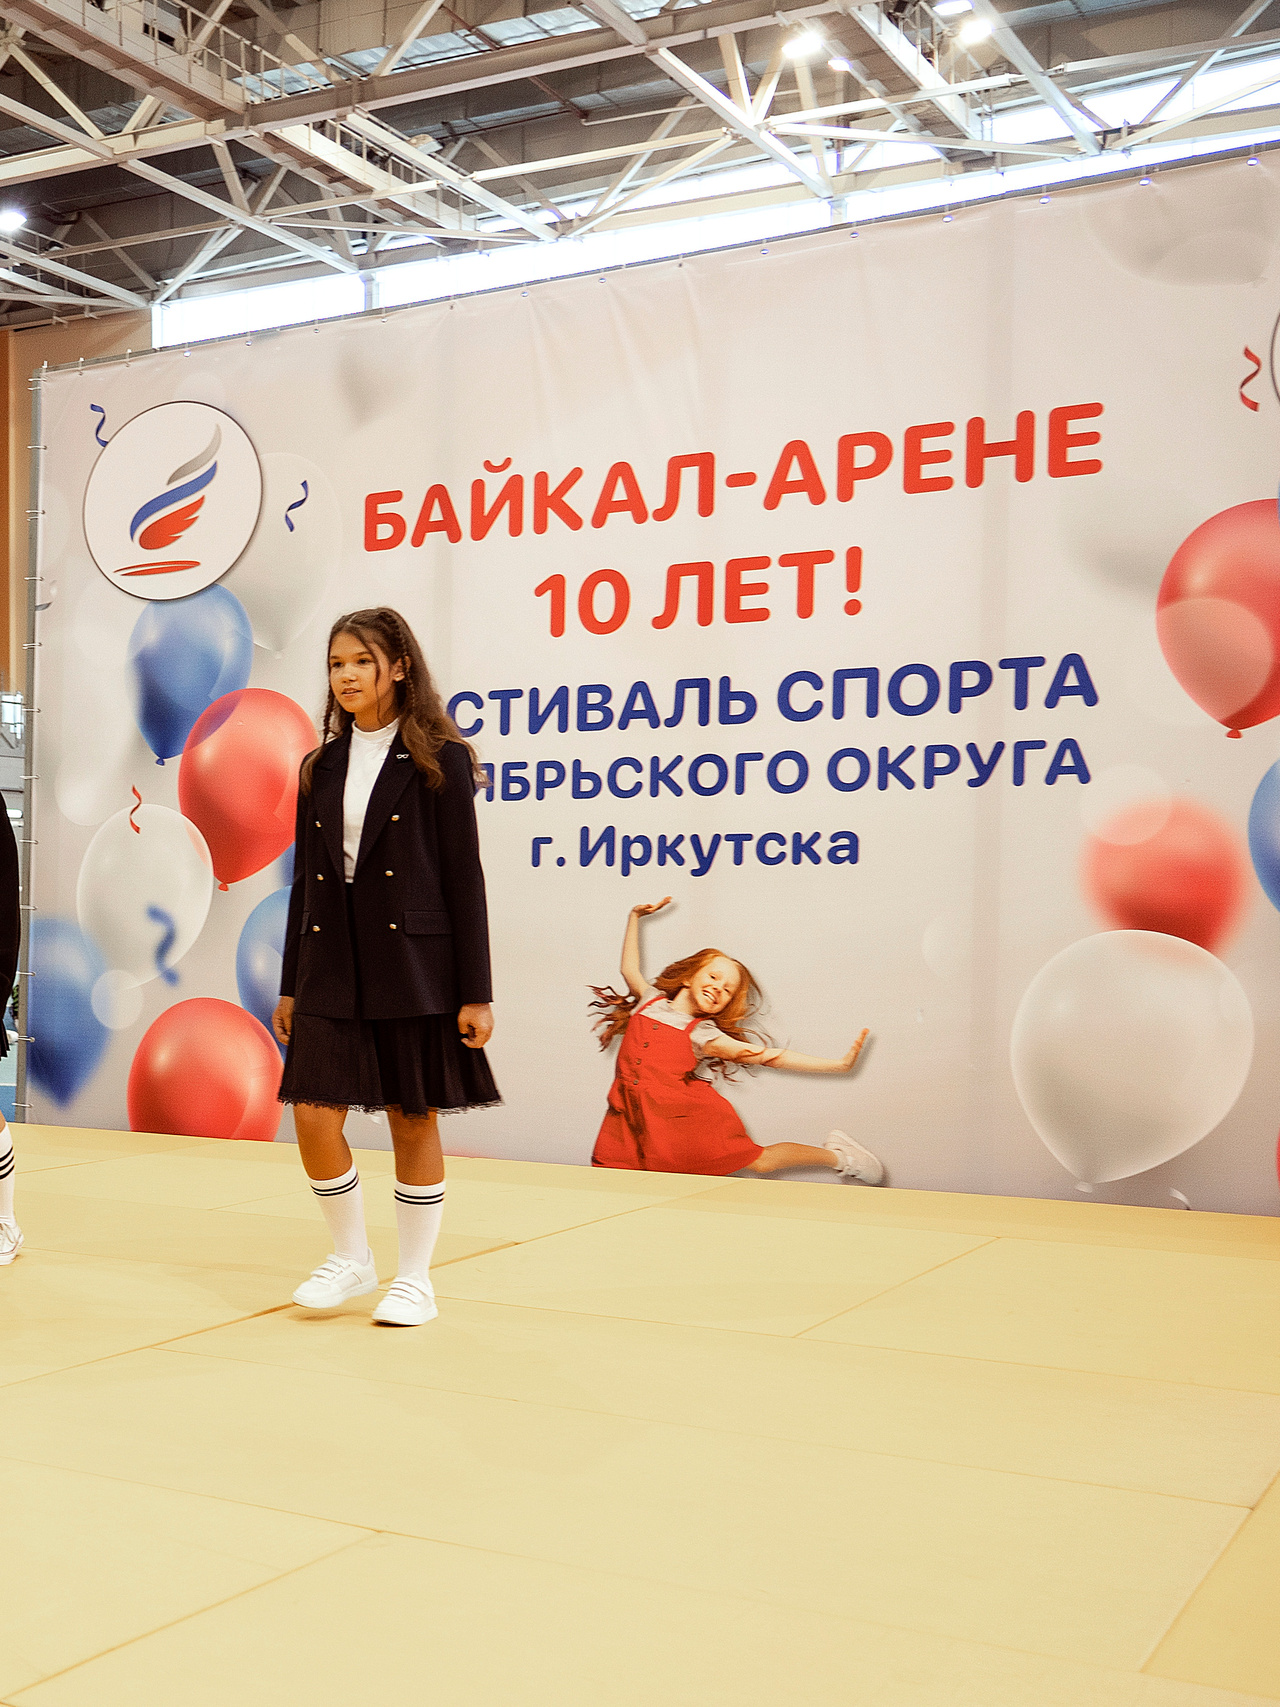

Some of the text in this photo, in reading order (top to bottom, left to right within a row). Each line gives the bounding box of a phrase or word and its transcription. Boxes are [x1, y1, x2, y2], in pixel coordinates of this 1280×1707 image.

[363, 401, 1105, 553] БАЙКАЛ-АРЕНЕ
[533, 545, 864, 639] 10 ЛЕТ!
[776, 652, 1099, 723] СПОРТА
[826, 737, 1092, 793] ОКРУГА
[578, 825, 861, 878] Иркутска
